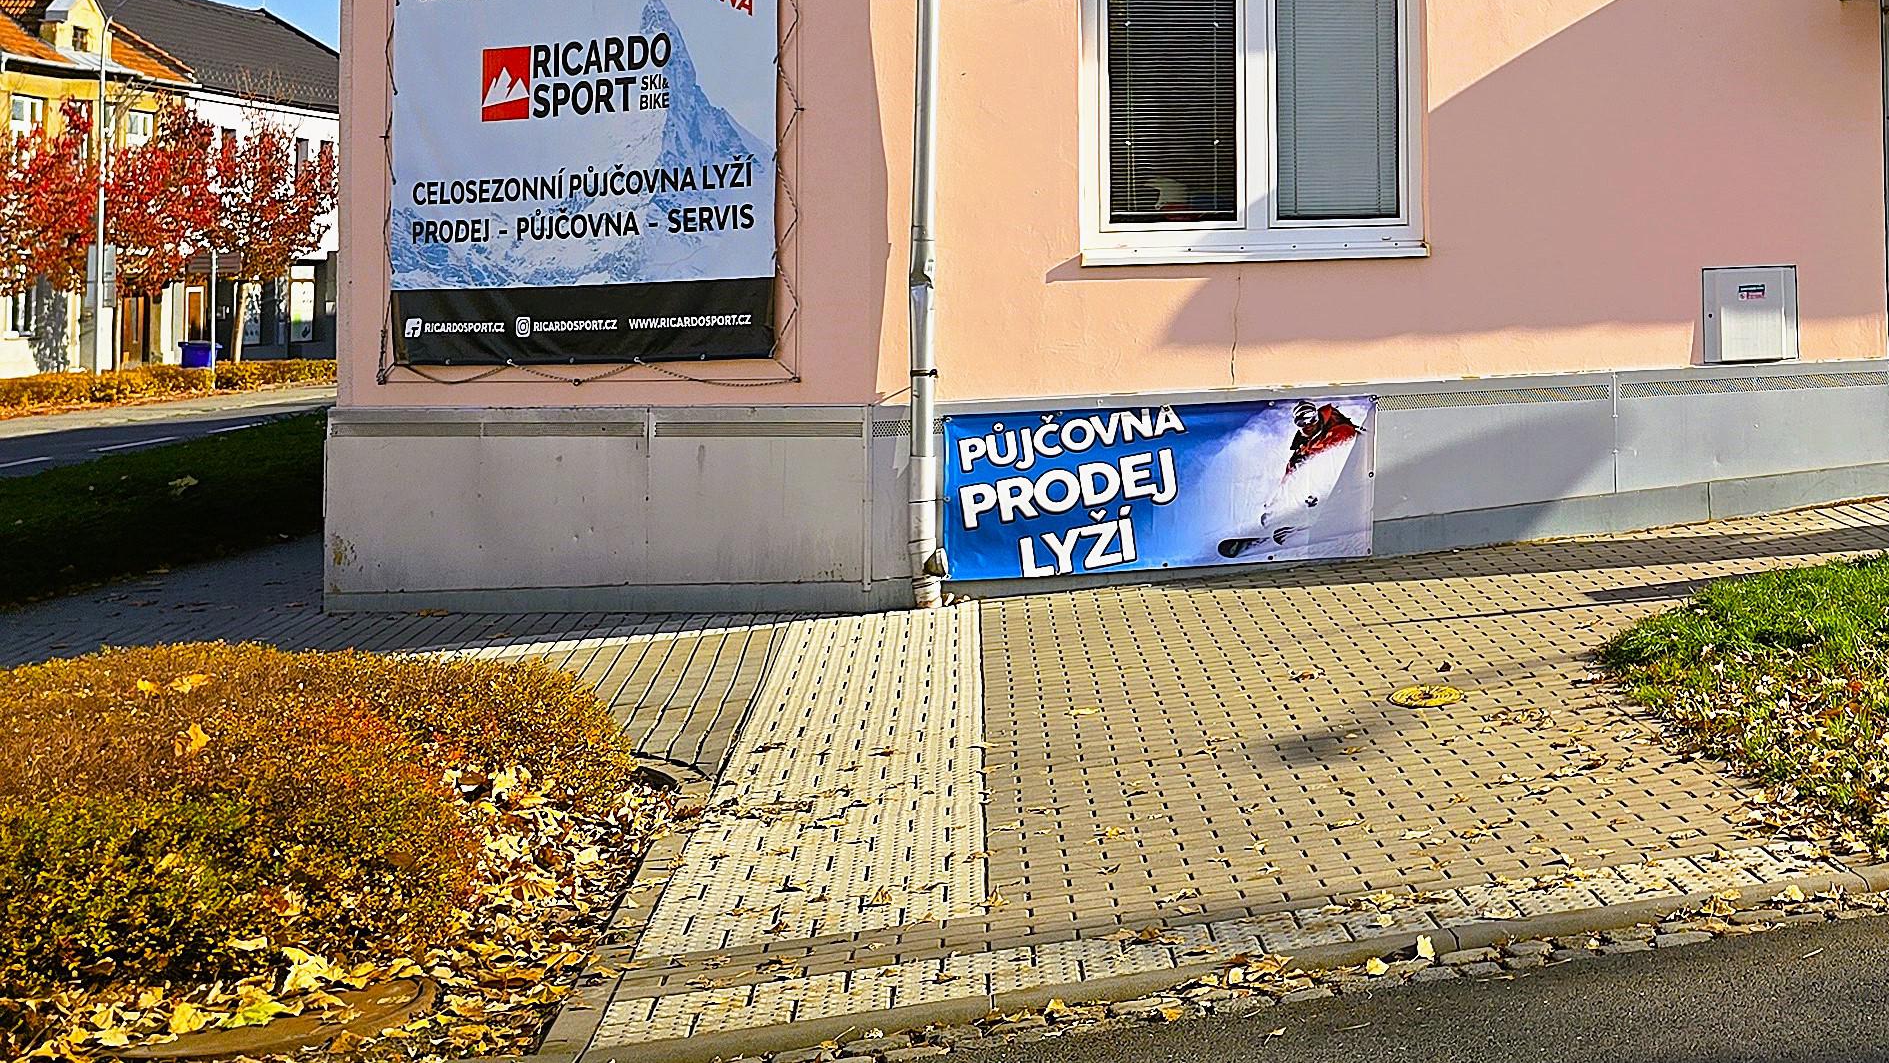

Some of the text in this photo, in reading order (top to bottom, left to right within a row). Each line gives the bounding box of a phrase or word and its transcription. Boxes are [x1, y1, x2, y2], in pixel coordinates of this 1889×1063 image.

[533, 32, 671, 78] RICARDO
[532, 76, 637, 119] SPORT
[639, 91, 670, 111] BIKE
[641, 74, 669, 92] SKI&
[413, 154, 755, 206] CELOSEZONNÍ PŮJČOVNA LYŽÍ
[412, 219, 490, 245] PRODEJ
[516, 207, 640, 241] PŮJČOVNA
[667, 203, 755, 234] SERVIS
[424, 314, 752, 334] RICARDOSPORT.CZ RICARDOSPORT.CZ WWW.RICARDOSPORT.CZ
[958, 404, 1186, 473] PŮJČOVNA
[957, 448, 1178, 530] PRODEJ
[1017, 506, 1138, 579] LYŽÍ
